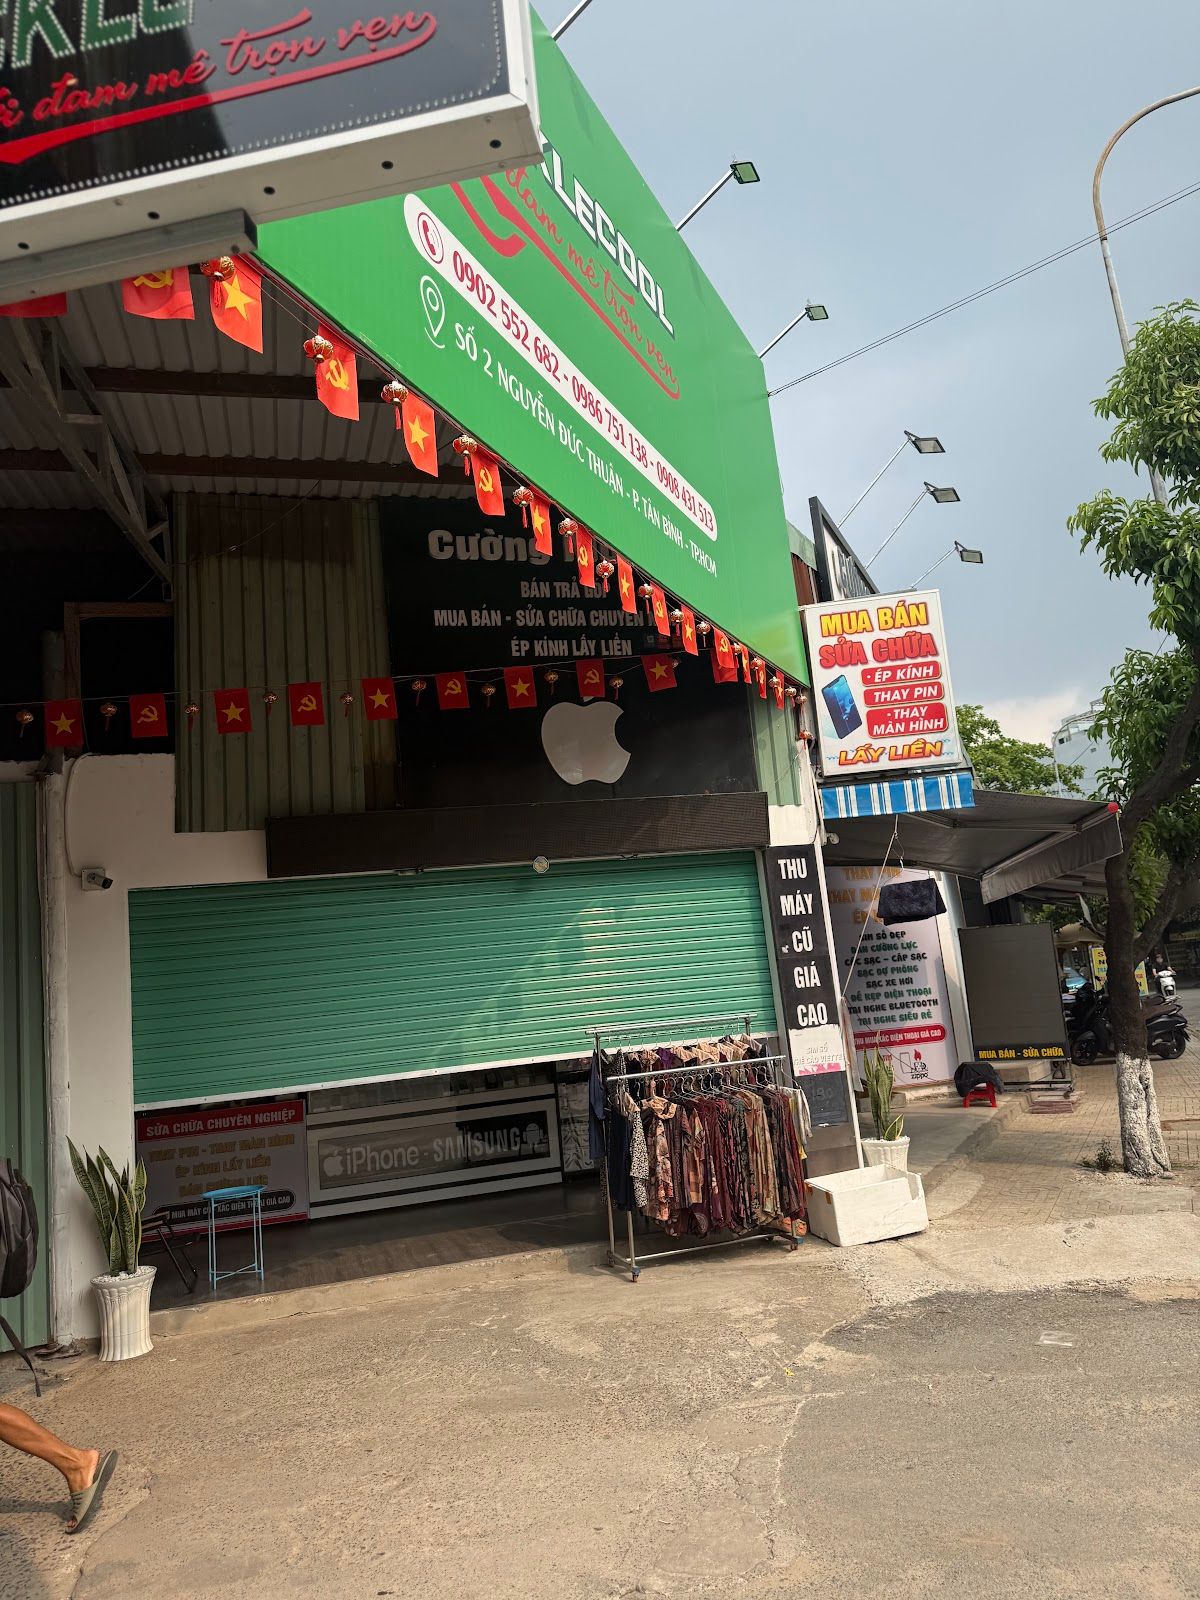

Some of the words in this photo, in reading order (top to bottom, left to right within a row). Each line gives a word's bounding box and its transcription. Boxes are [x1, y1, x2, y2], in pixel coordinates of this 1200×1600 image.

[32, 72, 138, 121] đam
[145, 49, 216, 95] mê
[220, 7, 326, 75] trọn
[338, 10, 437, 52] vẹn
[600, 264, 642, 342] trọn
[453, 250, 497, 318] 0902
[501, 298, 530, 352] 552
[534, 336, 561, 383] 682
[572, 375, 603, 425] 0986
[604, 407, 627, 449] 751
[628, 432, 649, 469] 138
[656, 460, 680, 500] 0908
[681, 485, 698, 518] 431
[698, 500, 714, 533] 513
[455, 322, 478, 362] SỐ
[482, 347, 494, 378] 2
[497, 360, 556, 436] NGUYỄN
[585, 446, 624, 498] THUẬN
[641, 496, 661, 530] TÂN
[662, 514, 684, 549] BÌNH
[689, 539, 717, 578] TP.HCM
[520, 577, 551, 598] BÁN
[553, 576, 580, 598] TRẢ
[433, 609, 468, 627] MUA
[471, 604, 502, 627] BÁN
[515, 604, 545, 627] SỬA
[548, 606, 587, 627] CHỮA
[819, 609, 873, 638] MUA
[876, 600, 929, 631] BÁN
[510, 636, 531, 657] ÉP
[533, 634, 569, 657] KÍNH
[571, 632, 600, 656] LẤY
[601, 631, 632, 656] LIỀN
[818, 636, 868, 670] SỬA
[871, 631, 939, 664] CHỮA
[874, 665, 895, 683] ÉP
[896, 662, 935, 681] KÍNH
[873, 687, 912, 703] THAY
[913, 684, 939, 699] PIN
[872, 718, 907, 736] MÀN
[908, 715, 945, 732] HÌNH
[893, 706, 928, 719] THAY
[837, 743, 885, 766] LẤY
[888, 738, 943, 761] LIỀN
[777, 857, 808, 880] THU
[779, 889, 814, 917] MÁY
[791, 926, 813, 953] CŨ
[793, 960, 822, 988] GIÁ
[885, 978, 896, 987] XE
[796, 1002, 828, 1027] CAO
[863, 1003, 887, 1013] NGHE
[889, 998, 939, 1010] BLUETOOTH
[873, 1014, 897, 1024] NGHE
[978, 1050, 996, 1059] MUA
[998, 1046, 1015, 1058] BÁN
[1023, 1045, 1040, 1057] SỬA
[1041, 1045, 1064, 1057] CHỮA
[146, 1121, 170, 1137] SỬA
[172, 1118, 204, 1134] CHỮA
[207, 1114, 252, 1130] CHUYÊN
[255, 1108, 296, 1124] NGHIỆP
[345, 1143, 420, 1175] iPhone
[432, 1126, 521, 1163] SAMSUNG
